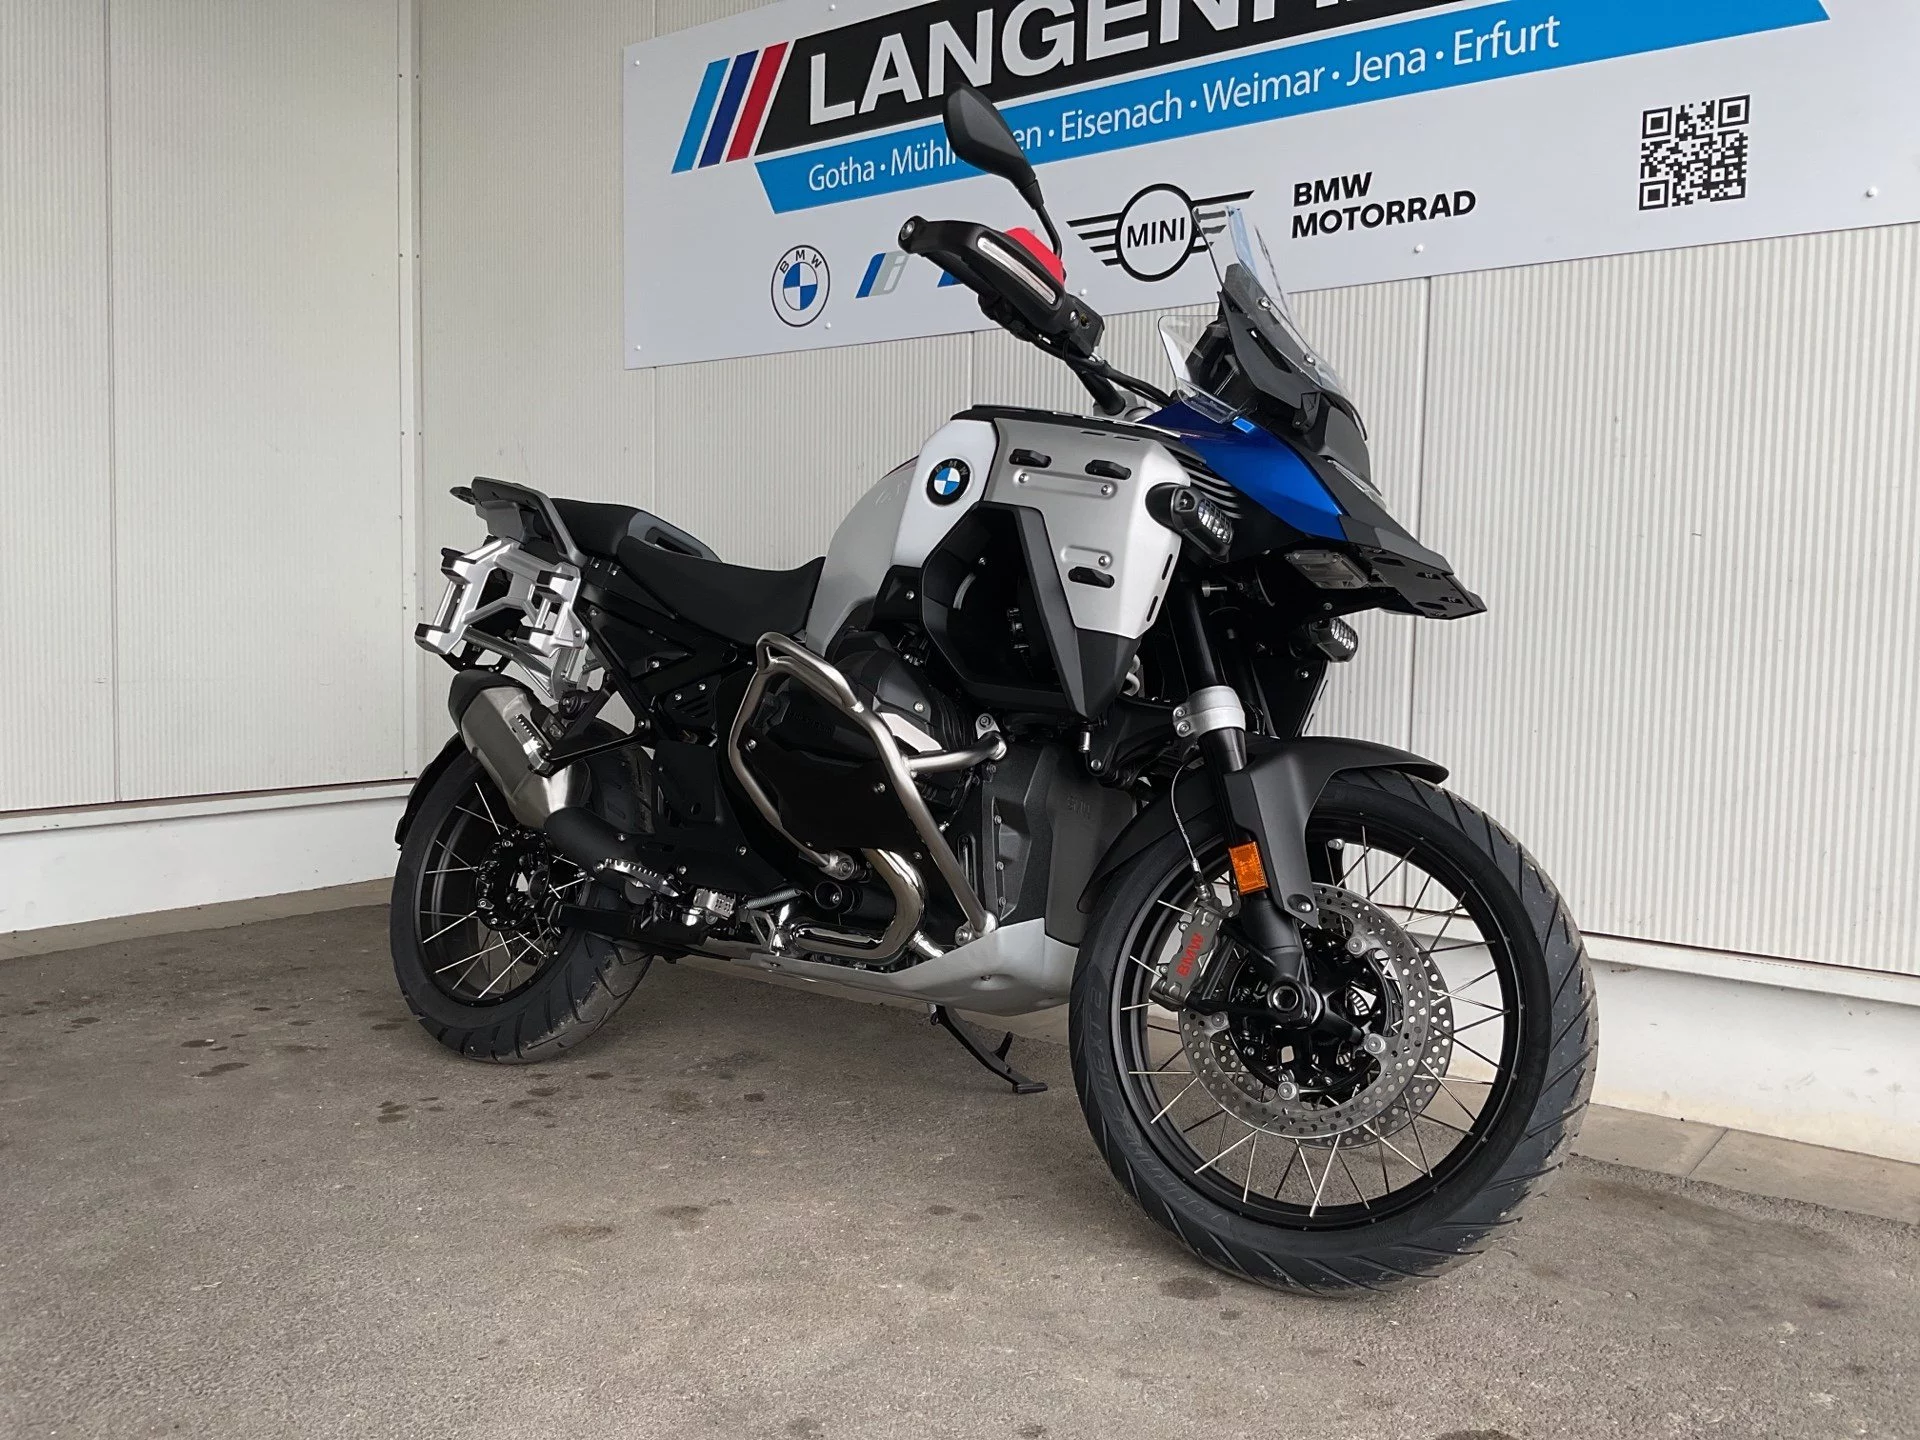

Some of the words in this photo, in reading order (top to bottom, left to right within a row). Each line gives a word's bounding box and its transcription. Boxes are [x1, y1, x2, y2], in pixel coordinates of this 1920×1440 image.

[808, 157, 875, 191] Gotha
[1061, 88, 1183, 142] Eisenach
[1203, 66, 1325, 113] Weimar
[1346, 47, 1426, 86] Jena
[1454, 15, 1560, 65] Erfurt
[1293, 172, 1372, 207] BMW
[1292, 190, 1476, 239] MOTORRAD
[1127, 216, 1186, 249] MINI
[779, 250, 823, 274] BMW
[935, 460, 968, 476] BMW
[1176, 932, 1204, 977] BMW
